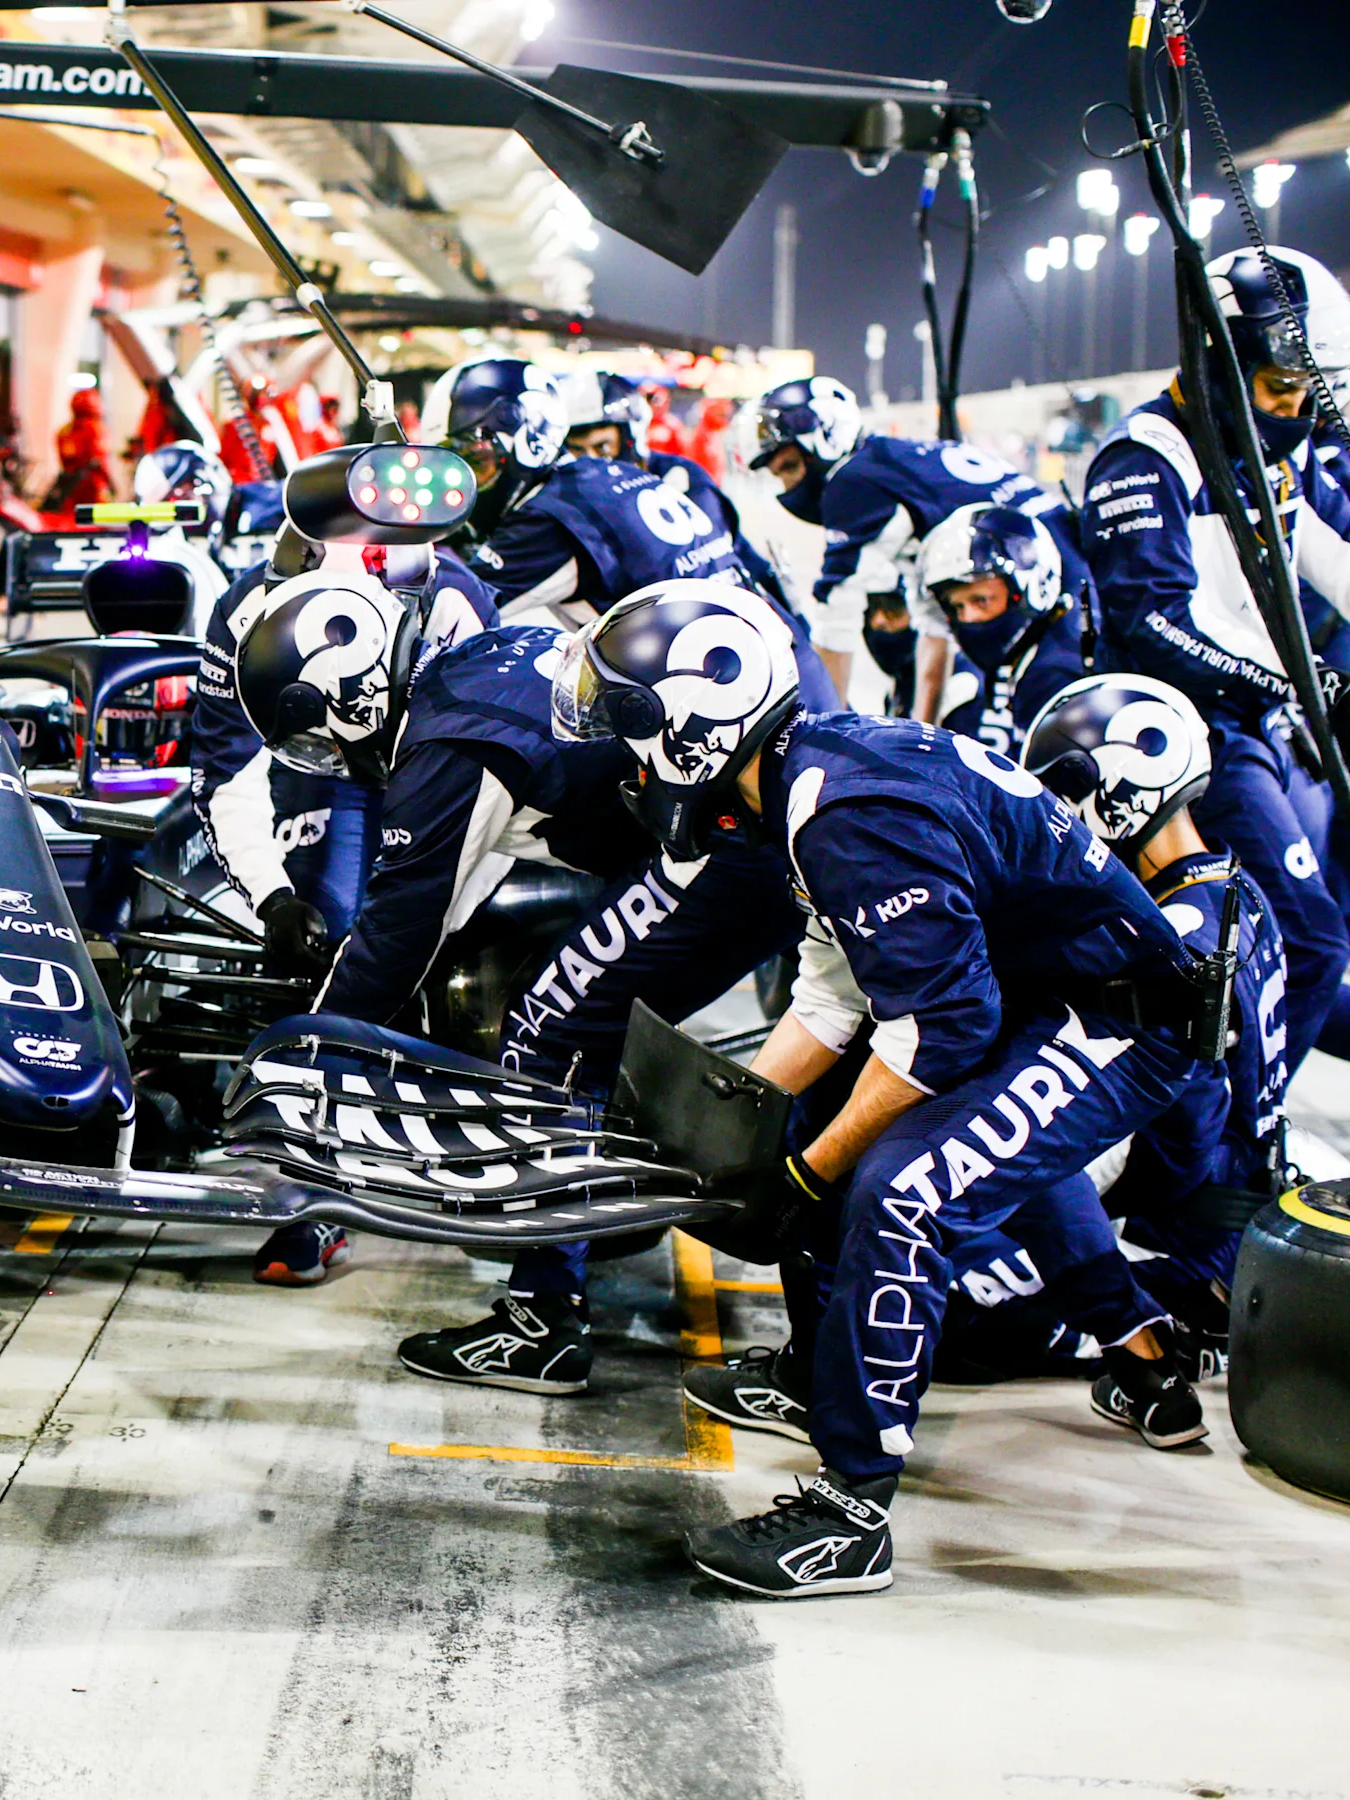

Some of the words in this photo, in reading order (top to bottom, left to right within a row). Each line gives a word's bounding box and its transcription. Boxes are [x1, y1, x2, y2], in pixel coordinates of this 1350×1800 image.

[1111, 472, 1161, 491] myWorld
[874, 887, 930, 924] RDS
[19, 1057, 82, 1071] ALPHATAURI
[863, 1044, 1090, 1407] ALPHATAURI
